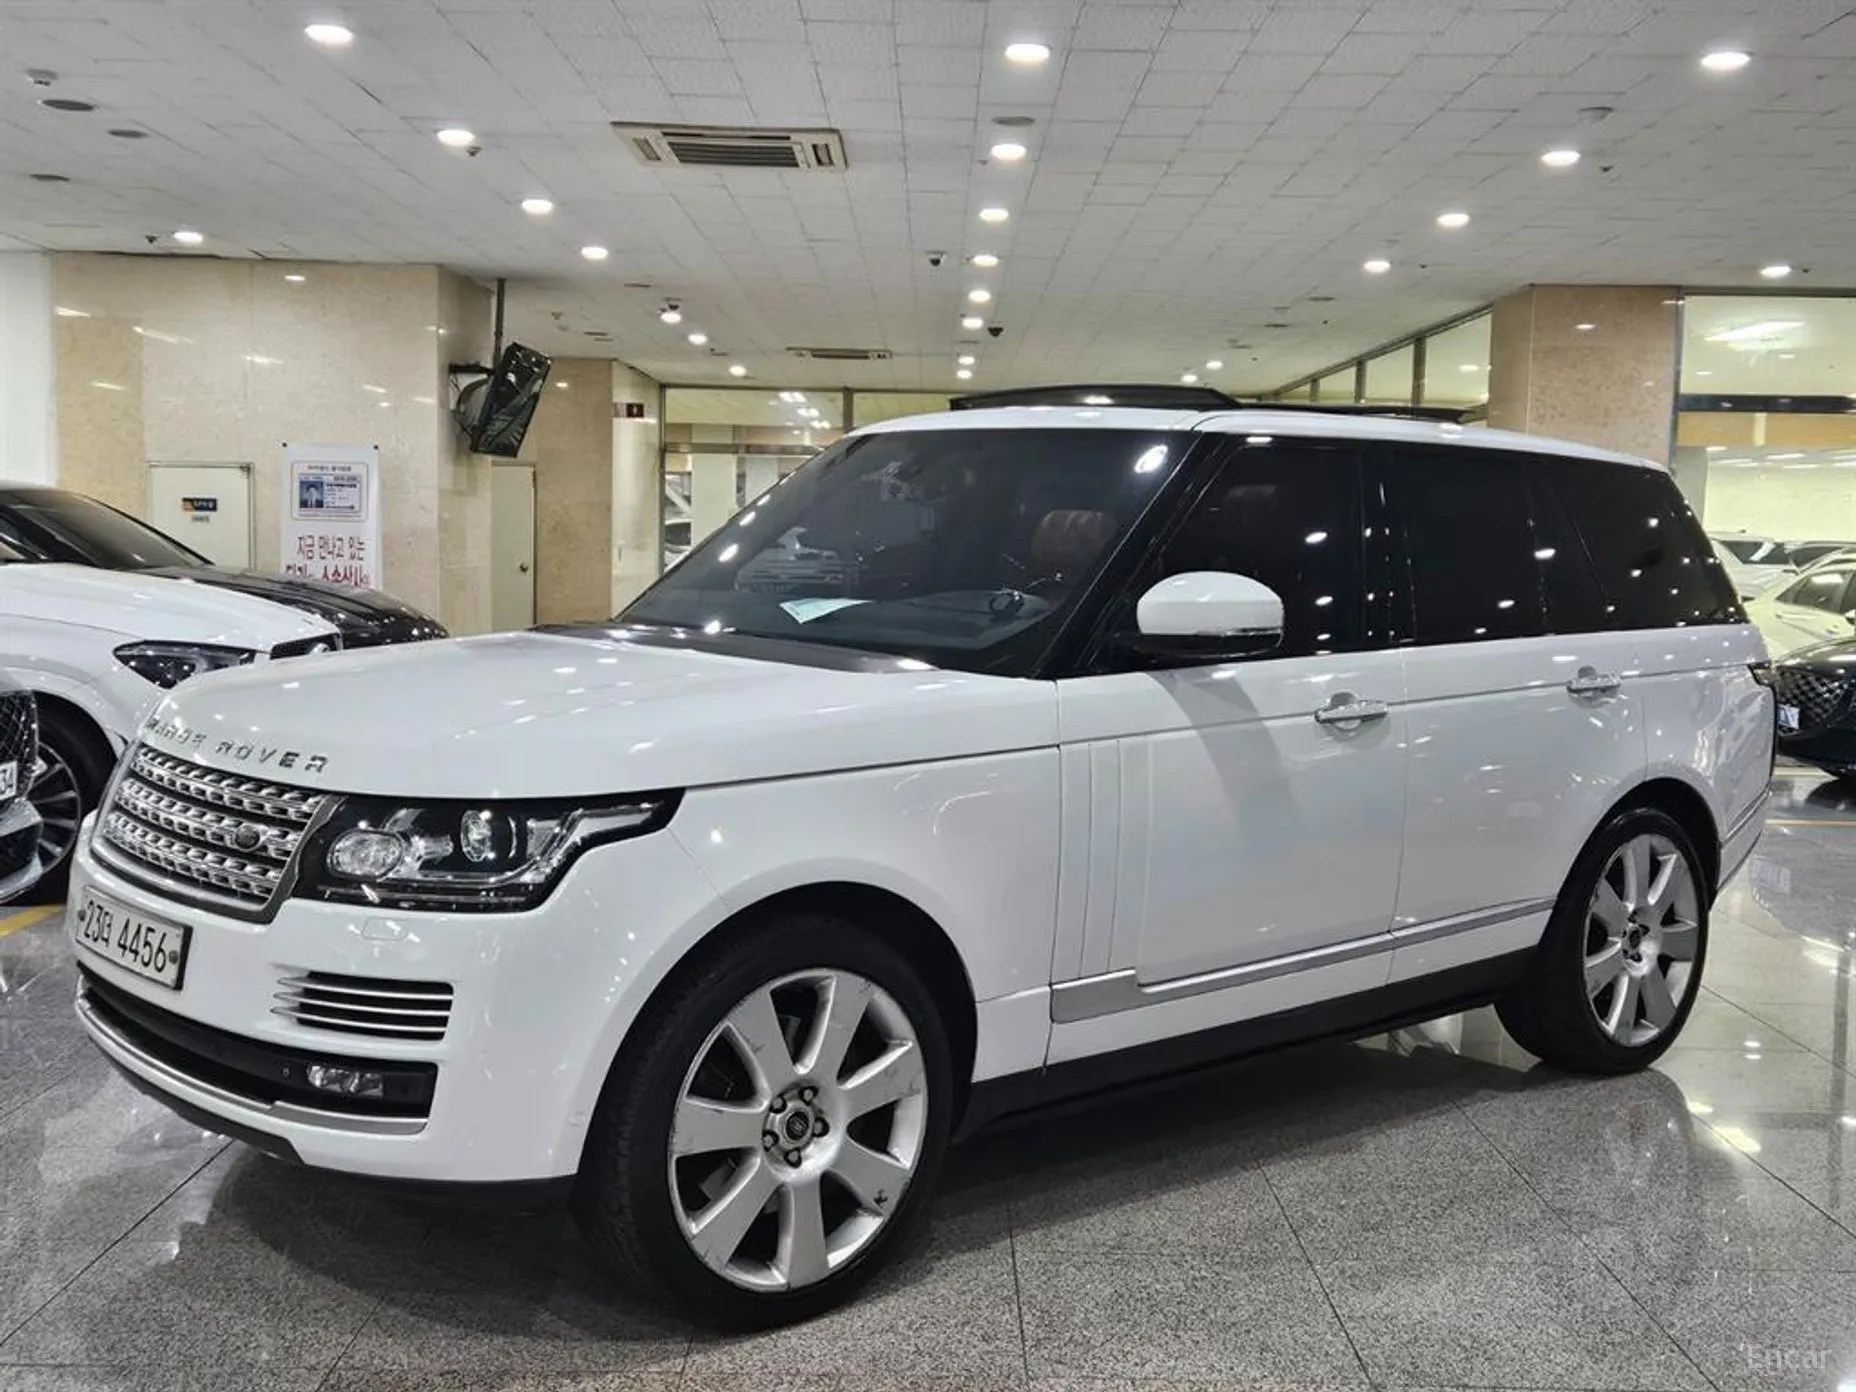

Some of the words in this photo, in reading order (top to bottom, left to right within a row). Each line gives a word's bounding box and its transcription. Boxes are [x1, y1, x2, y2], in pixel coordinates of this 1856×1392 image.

[297, 534, 315, 560] 지금
[318, 535, 345, 560] 만나고
[348, 535, 365, 561] 있는
[215, 740, 328, 774] ROVER
[117, 917, 167, 973] 4456
